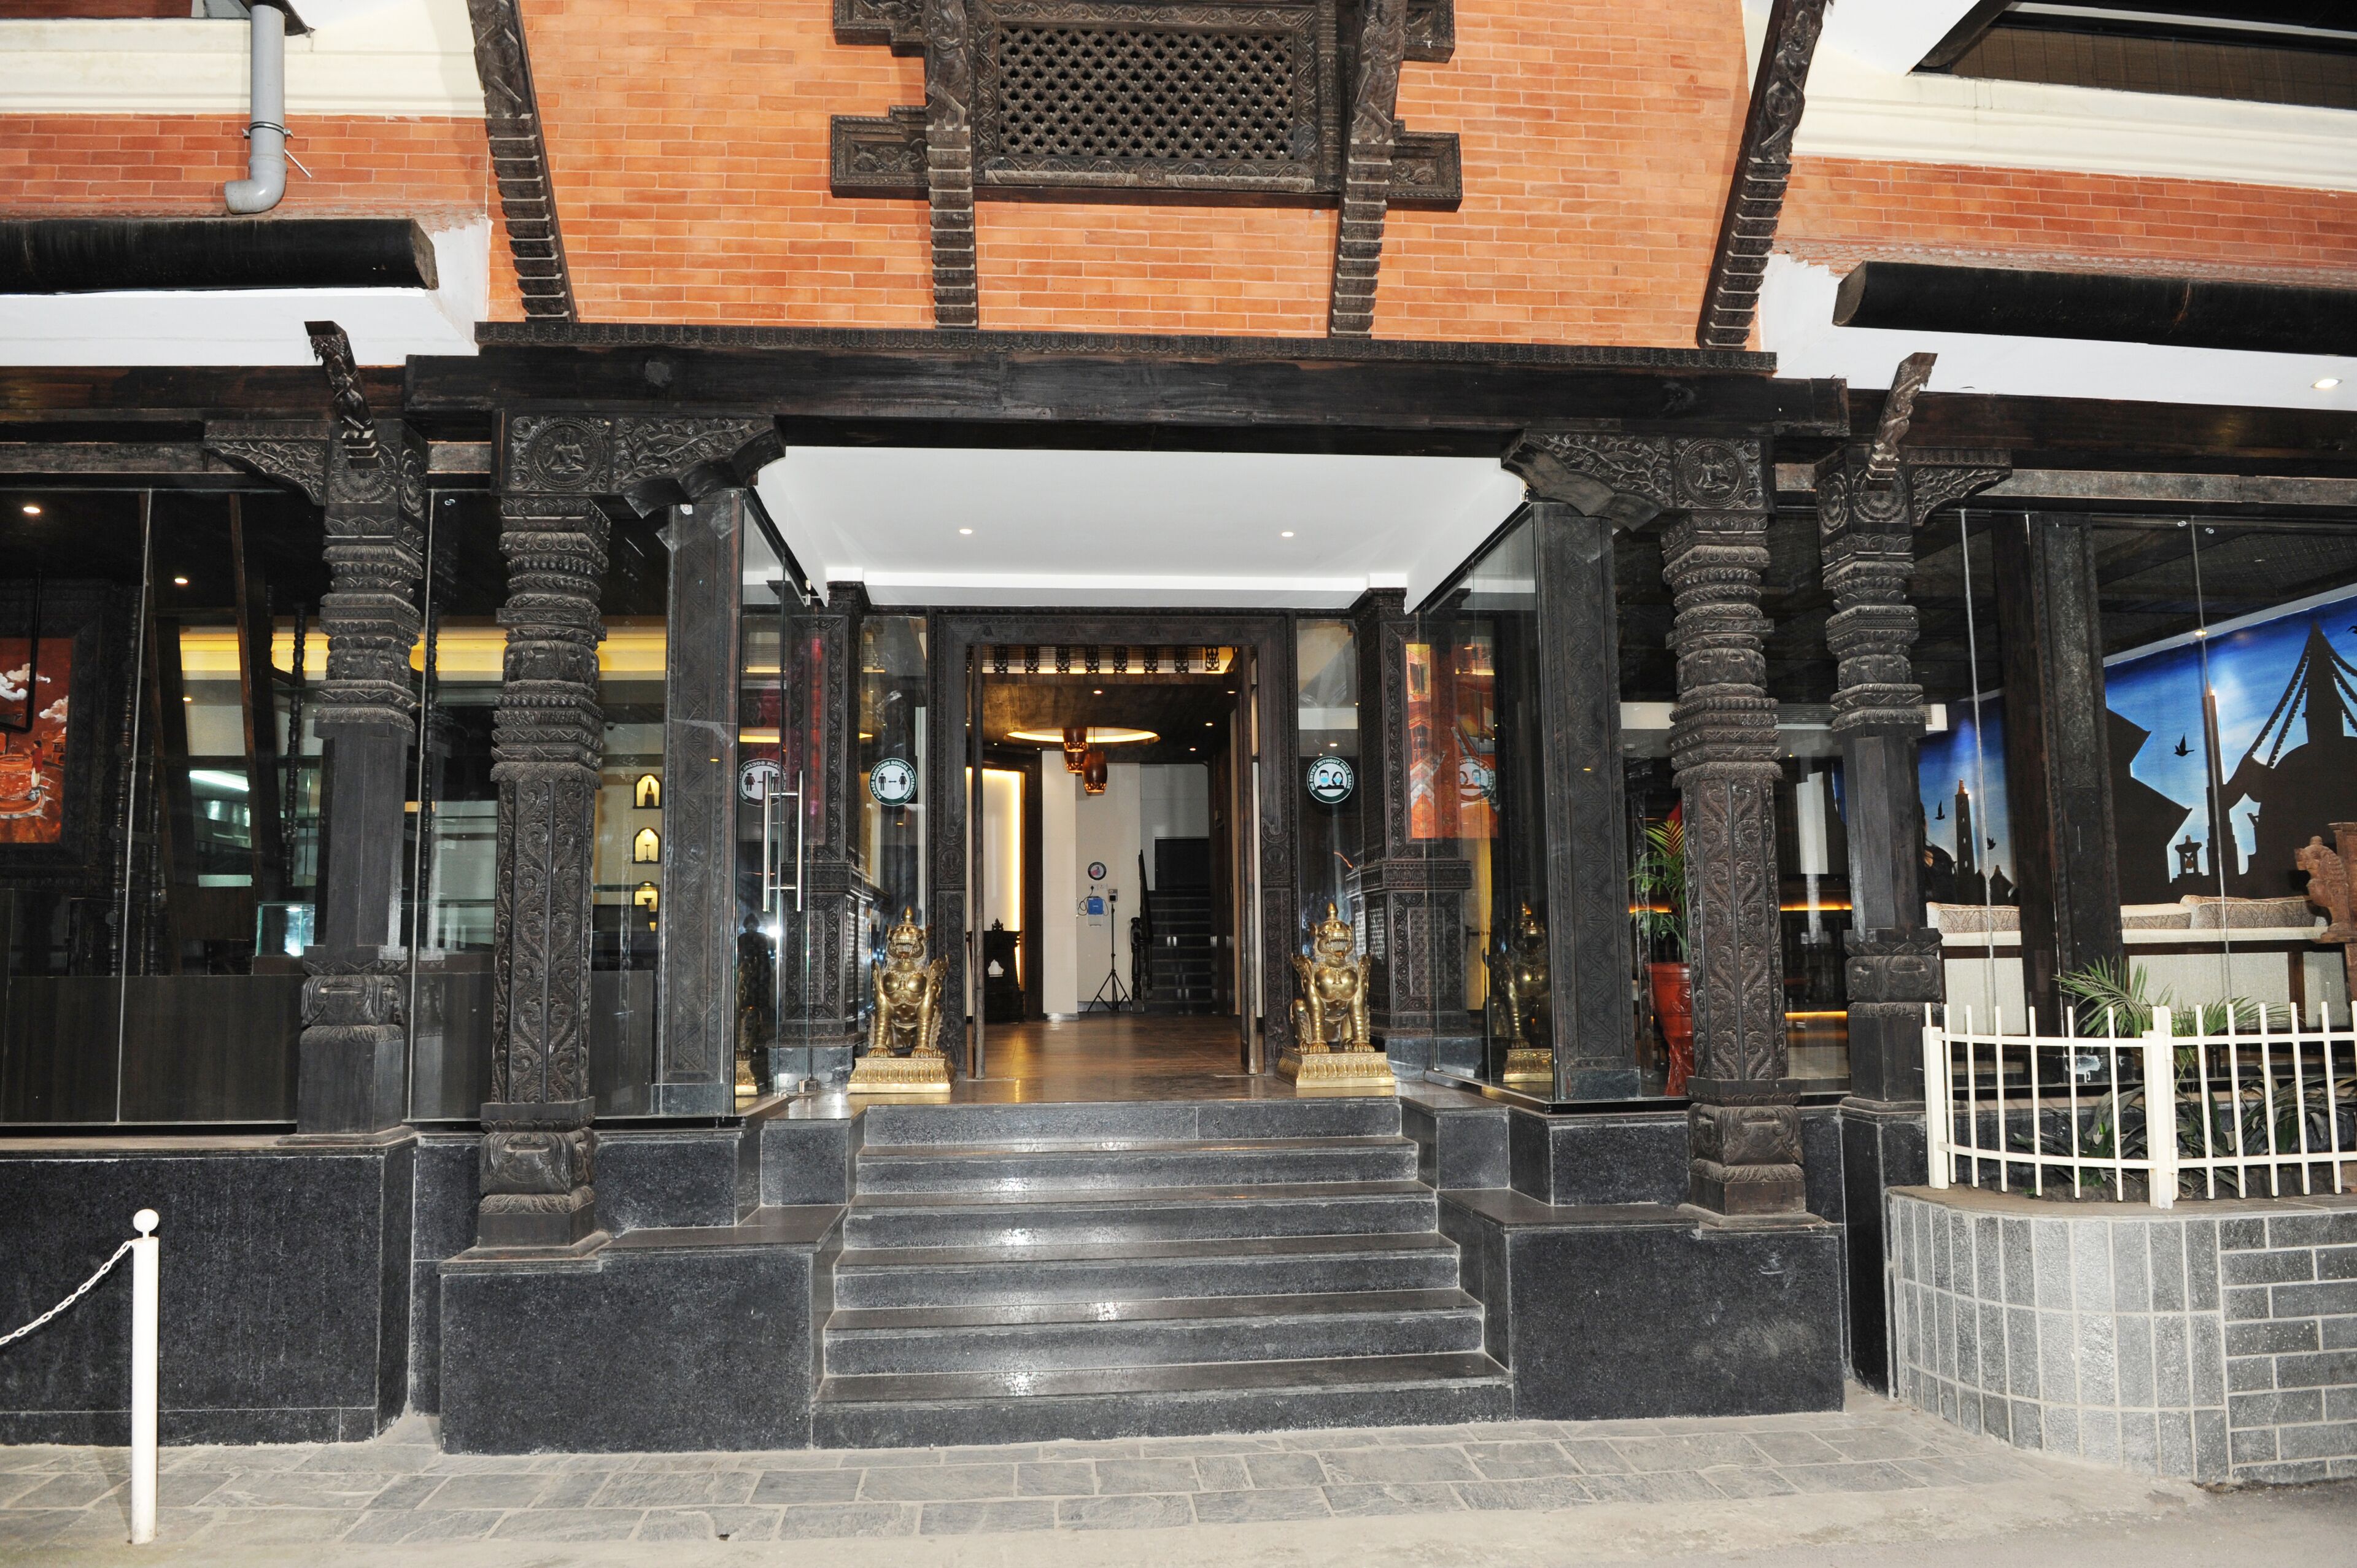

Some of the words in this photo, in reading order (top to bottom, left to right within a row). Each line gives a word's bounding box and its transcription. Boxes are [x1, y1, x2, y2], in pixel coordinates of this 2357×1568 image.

[871, 761, 890, 781] MAINTAIN
[891, 760, 908, 771] SOCIAL
[1309, 765, 1317, 782] ENTRY
[1340, 762, 1350, 774] FACE
[870, 781, 882, 800] PLEASE
[904, 770, 915, 800] DISTANCING
